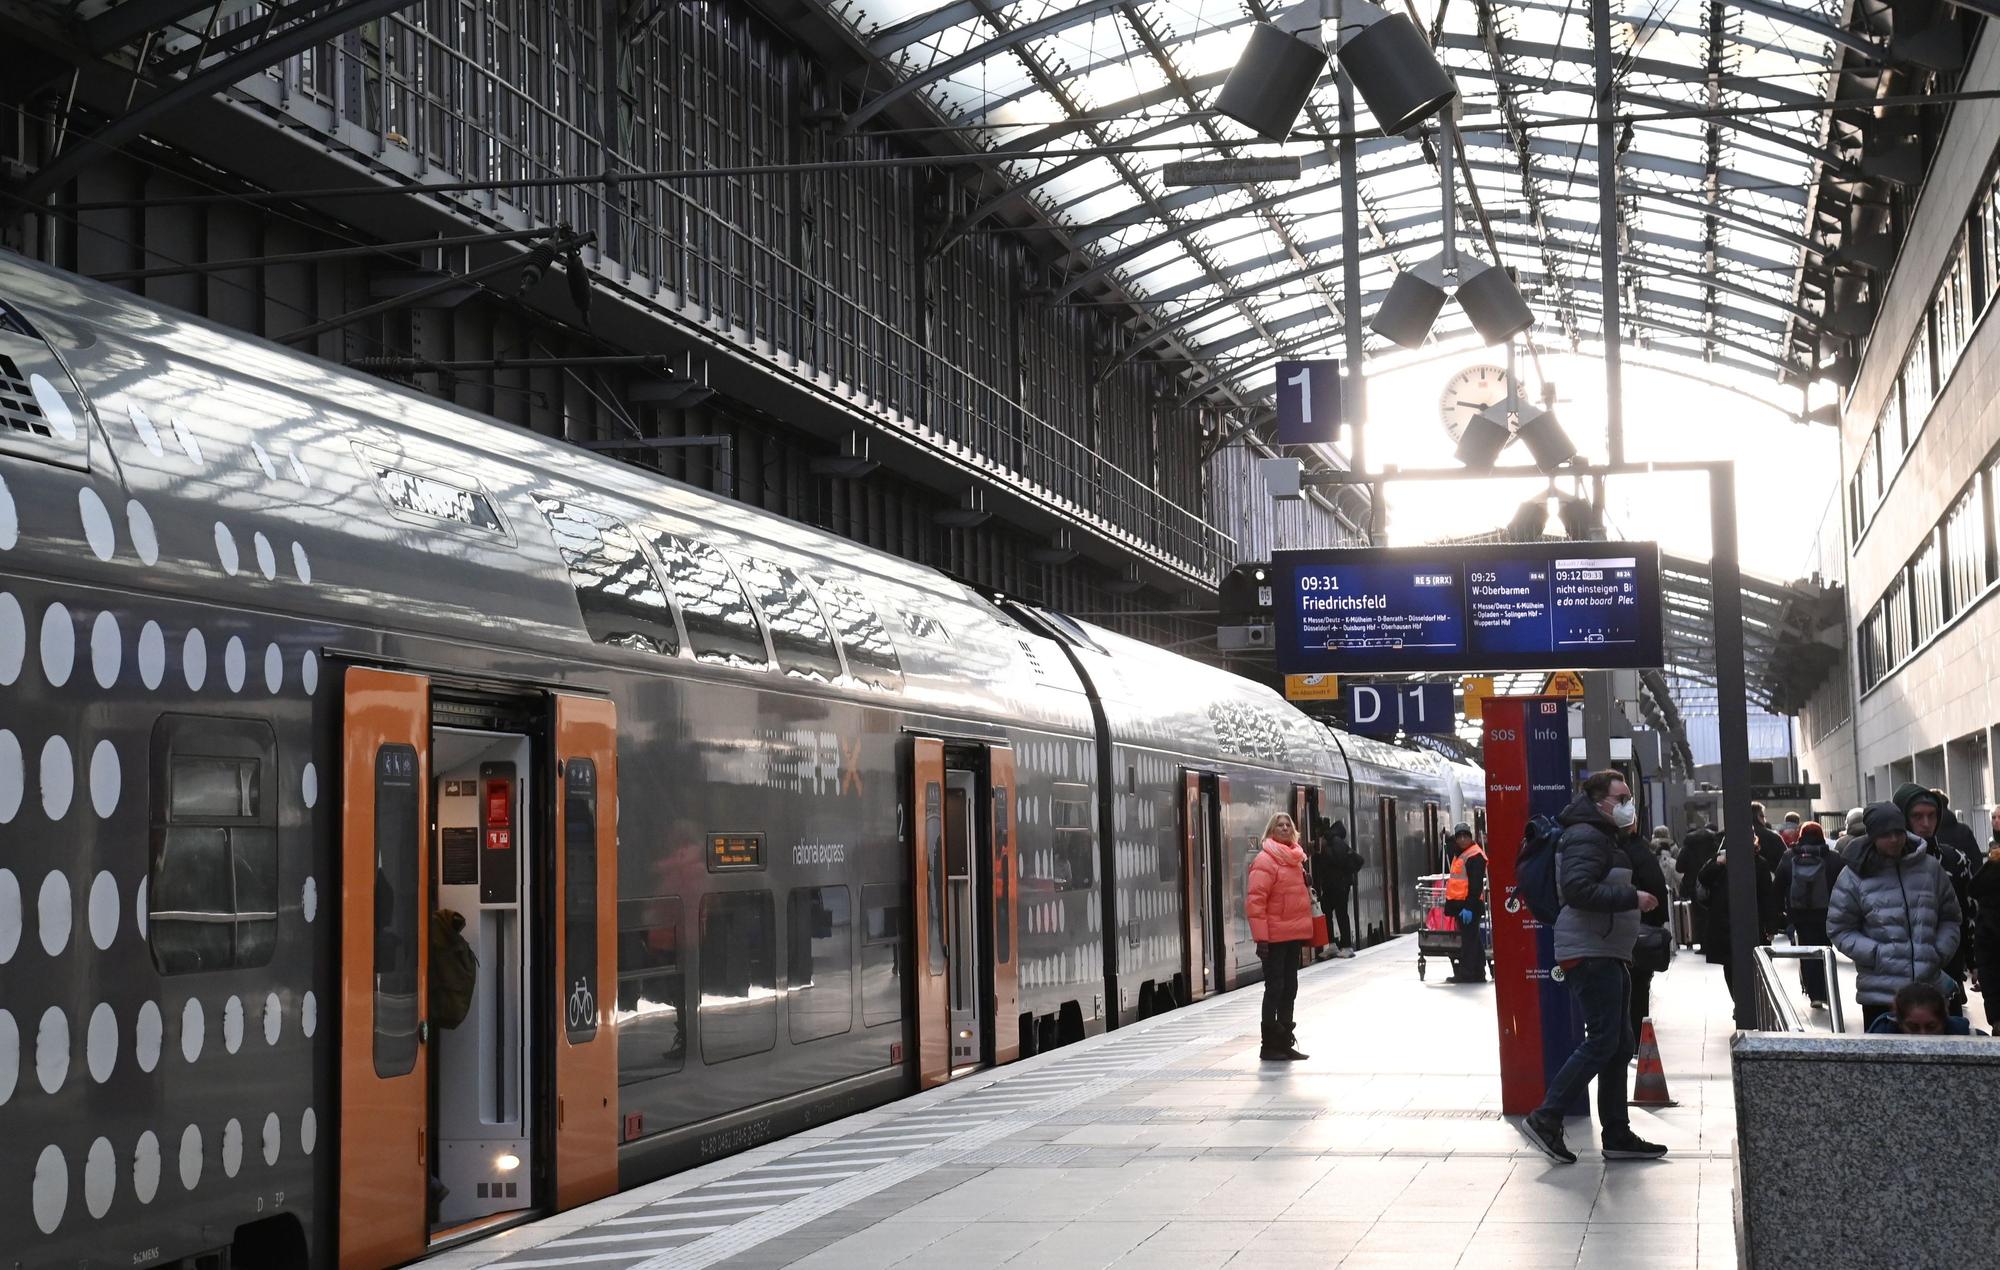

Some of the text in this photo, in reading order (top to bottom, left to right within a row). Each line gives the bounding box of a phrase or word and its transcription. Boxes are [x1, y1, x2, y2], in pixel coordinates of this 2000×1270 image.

[1288, 367, 1311, 423] 1
[1415, 575, 1452, 586] RE 5 (RRX)
[1471, 572, 1496, 582] 09:25
[1556, 571, 1581, 581] 09:12
[1301, 576, 1339, 591] 09:31
[1471, 585, 1530, 595] W-Oberbarmen
[1556, 584, 1576, 594] nicht
[1577, 584, 1619, 595] einsteigen
[1302, 594, 1387, 610] Friedrichsfeld
[1477, 602, 1511, 610] Messe/Deutz
[1563, 596, 1573, 606] do
[1574, 597, 1589, 606] not
[1589, 595, 1613, 606] board
[1307, 616, 1340, 624] Messe/Deutz
[1408, 614, 1436, 622] Düsseldorf
[1477, 611, 1499, 619] Opladen
[1504, 610, 1527, 619] Solingen
[1303, 624, 1331, 632] Düsseldorf
[1412, 622, 1422, 630] Hbf
[1473, 619, 1500, 627] Wuppertal
[1353, 686, 1381, 723] D
[1409, 685, 1425, 722] 1
[1541, 703, 1556, 713] DB
[1491, 729, 1516, 741] SOS
[1534, 728, 1558, 740] Info
[1532, 783, 1566, 791] Information
[897, 802, 904, 842] 2
[792, 837, 845, 871] national express
[257, 1196, 263, 1213] D
[133, 1247, 160, 1264] SIEMENS
